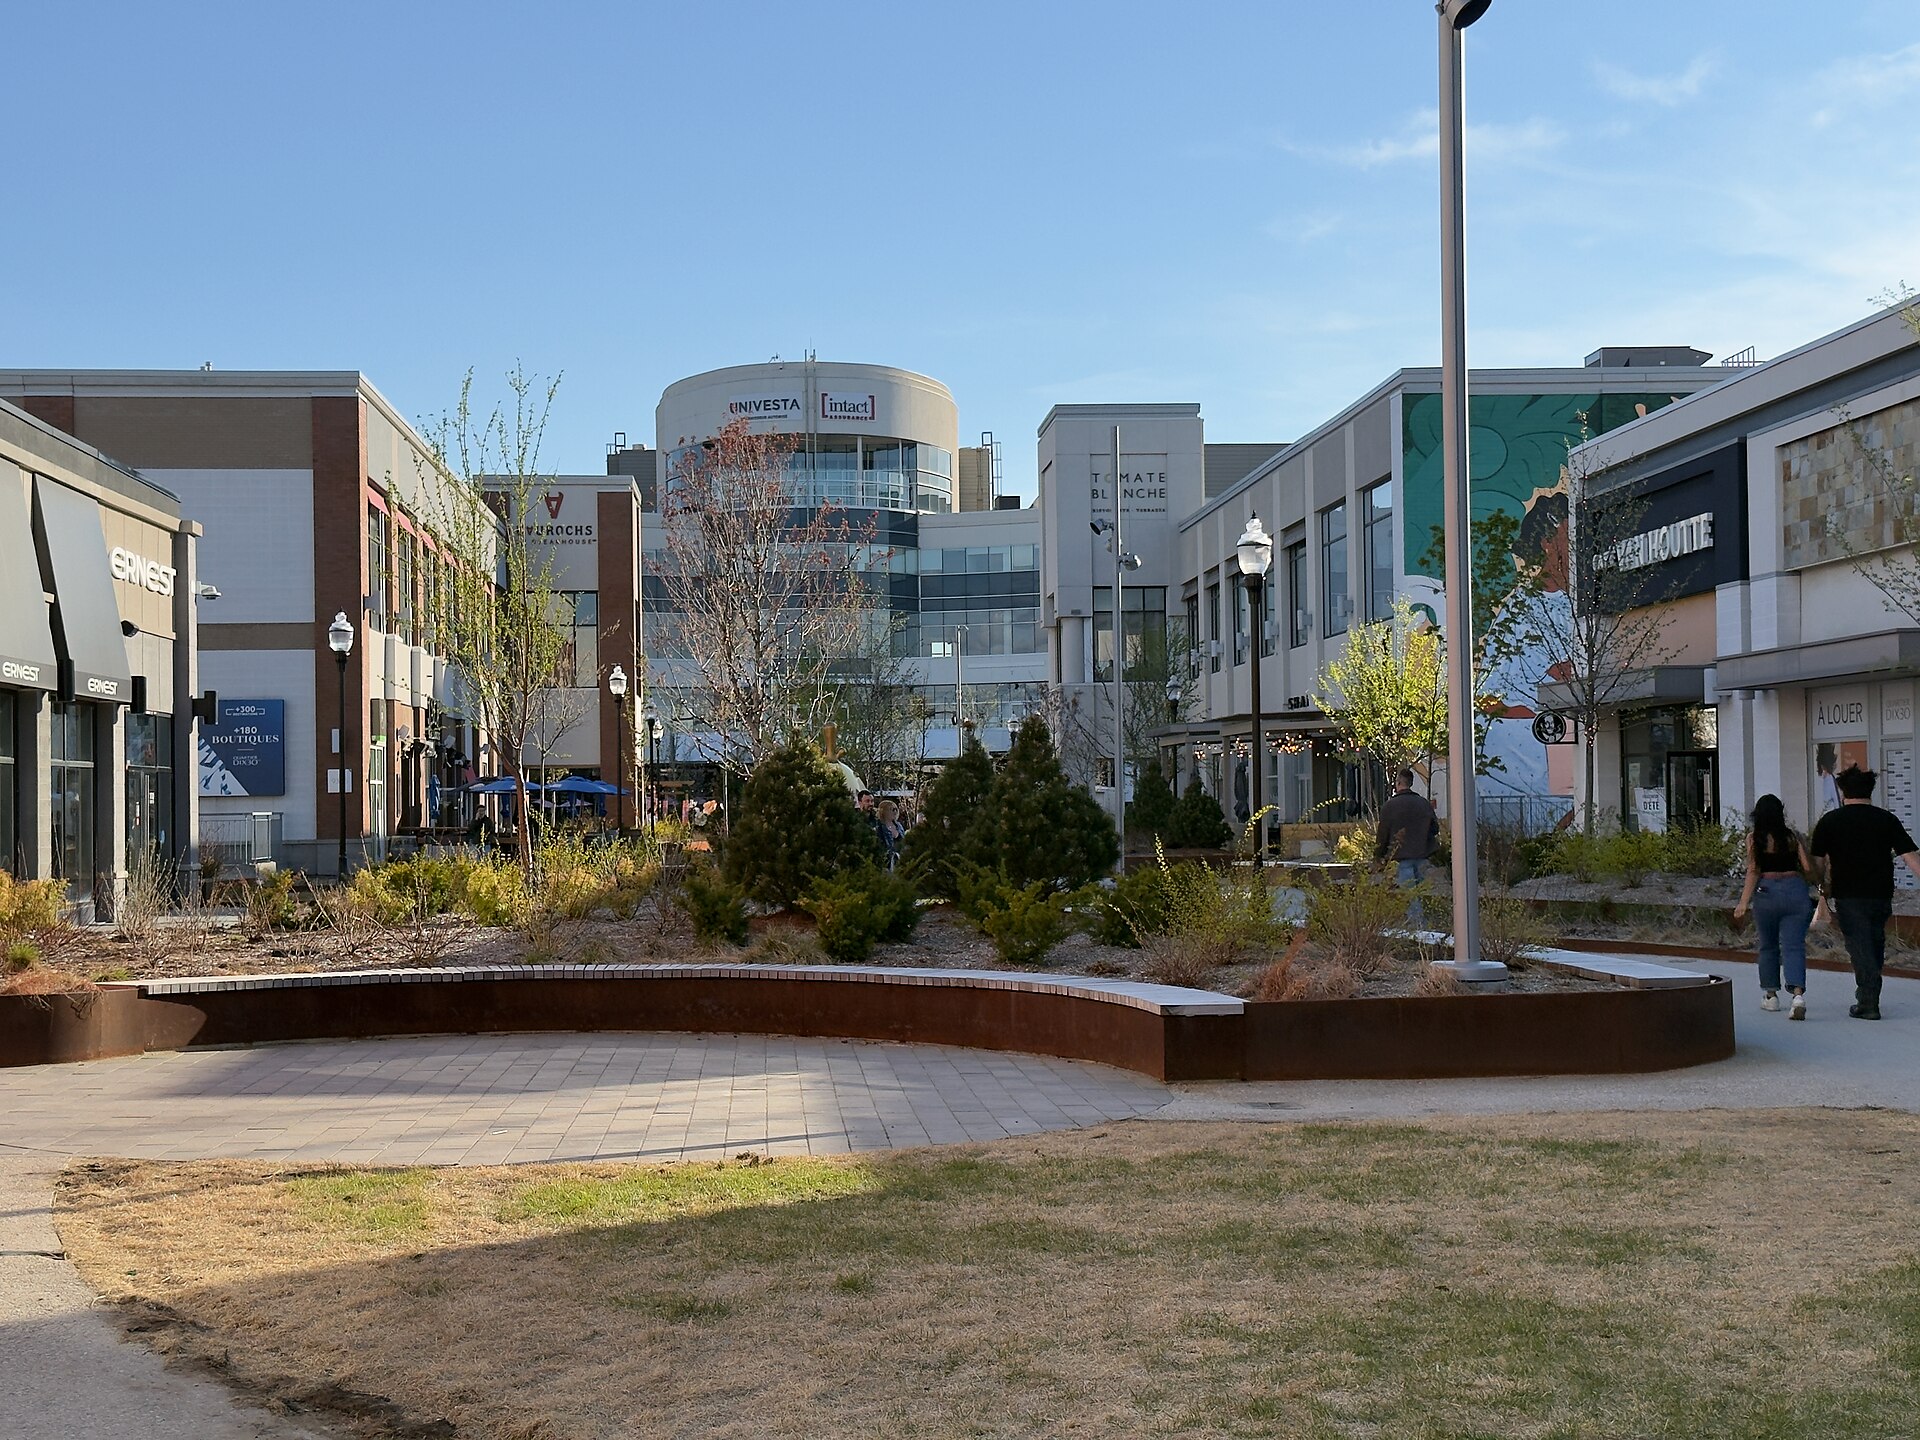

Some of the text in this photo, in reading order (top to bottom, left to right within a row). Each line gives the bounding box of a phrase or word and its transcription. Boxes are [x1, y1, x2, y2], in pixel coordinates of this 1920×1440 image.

[729, 398, 801, 414] UNIVESTA
[1092, 488, 1166, 499] BLNCHE
[111, 546, 178, 597] ERNEST
[2, 661, 40, 682] ERNEST
[87, 677, 119, 696] ERNEST
[235, 705, 256, 713] +300
[1817, 700, 1863, 726] À LOUER
[233, 726, 258, 734] +180
[212, 734, 280, 745] BOUTIQUES
